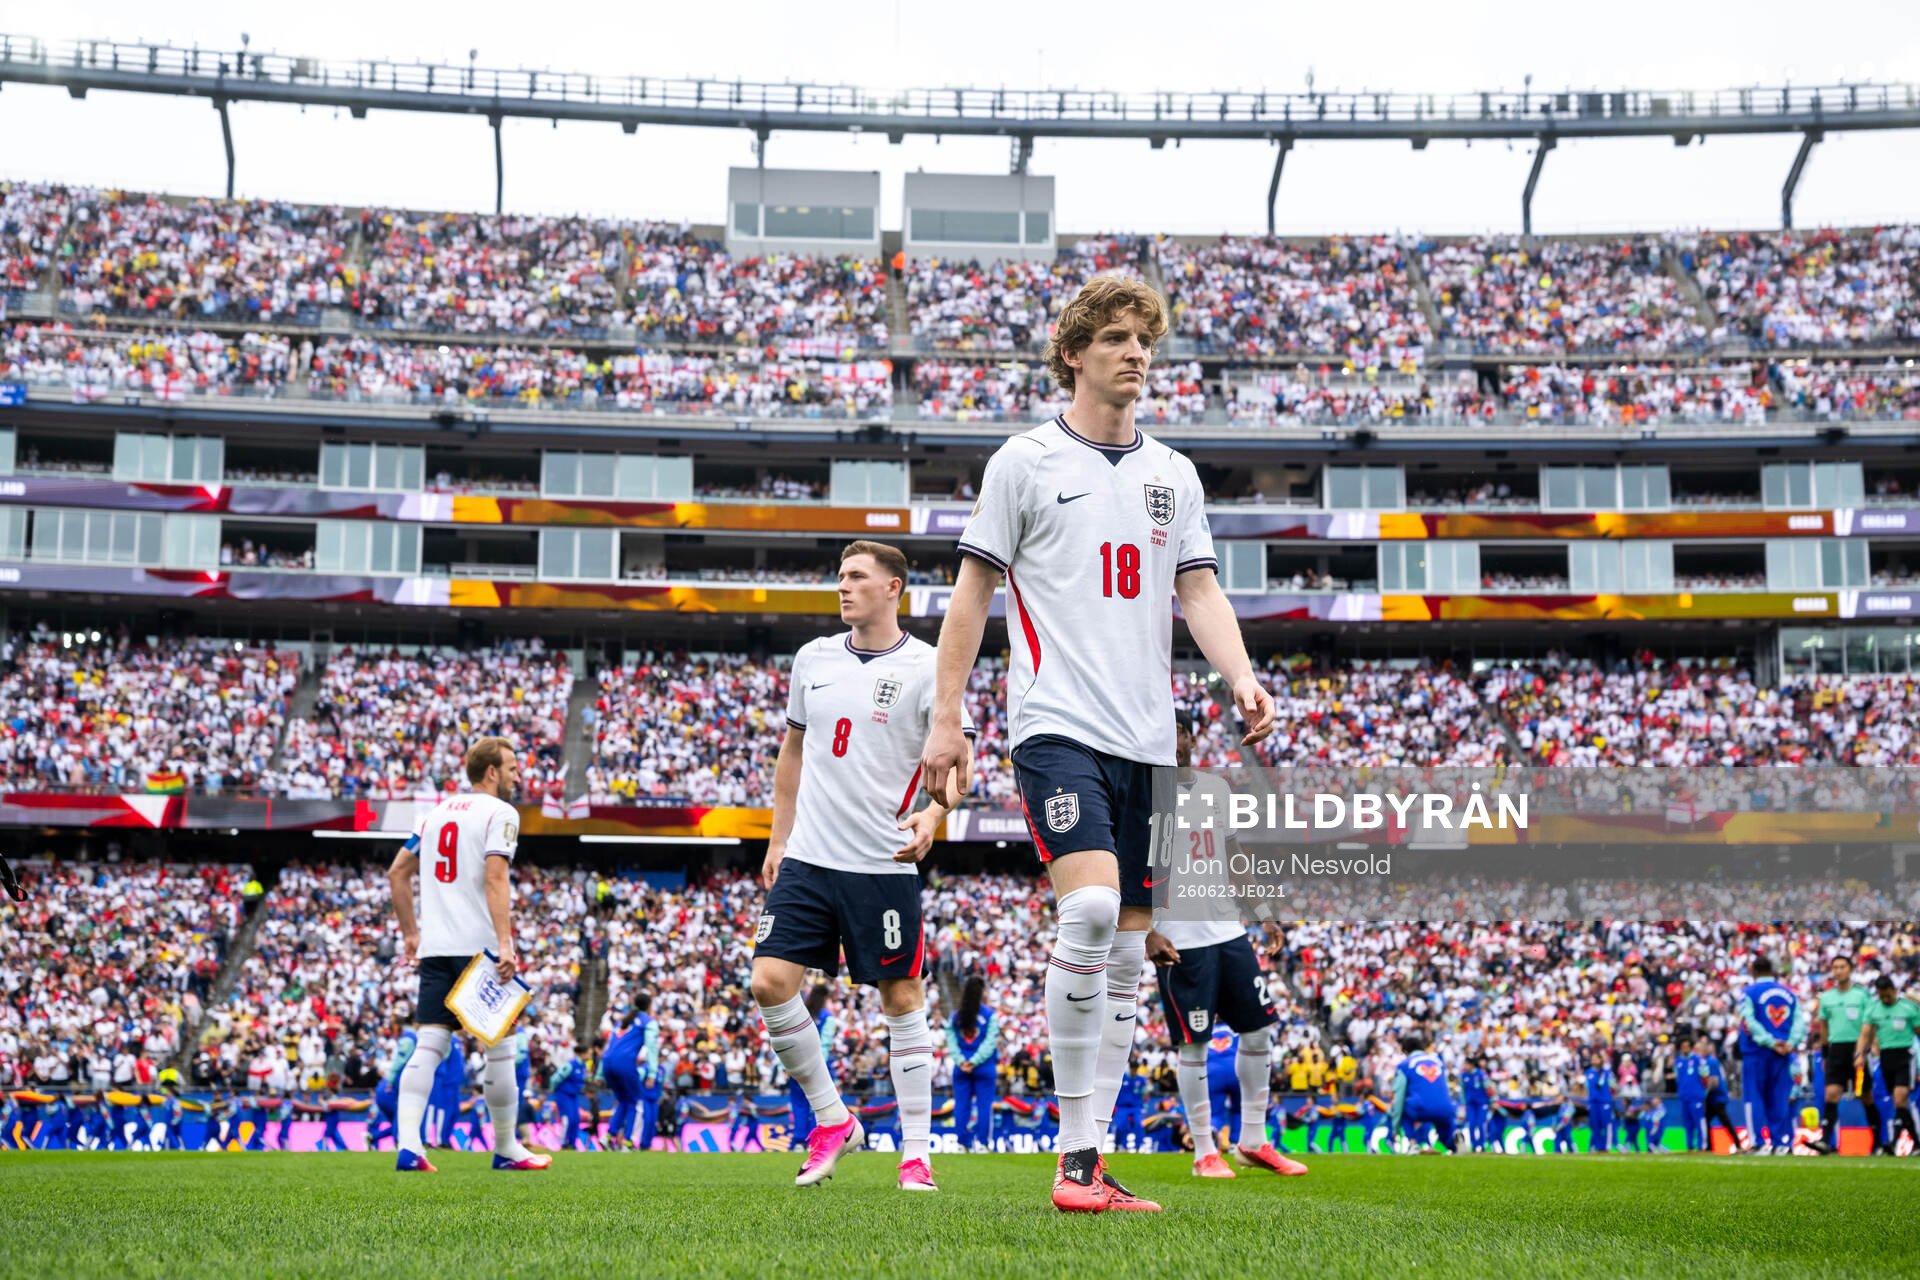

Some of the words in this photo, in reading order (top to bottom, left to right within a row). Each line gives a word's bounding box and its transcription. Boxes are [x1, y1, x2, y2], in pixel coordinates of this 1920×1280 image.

[1100, 541, 1140, 599] 18
[832, 717, 852, 758] 8
[435, 821, 459, 883] 9
[1147, 812, 1175, 867] 18
[1189, 829, 1216, 860] 20
[883, 909, 902, 950] 8
